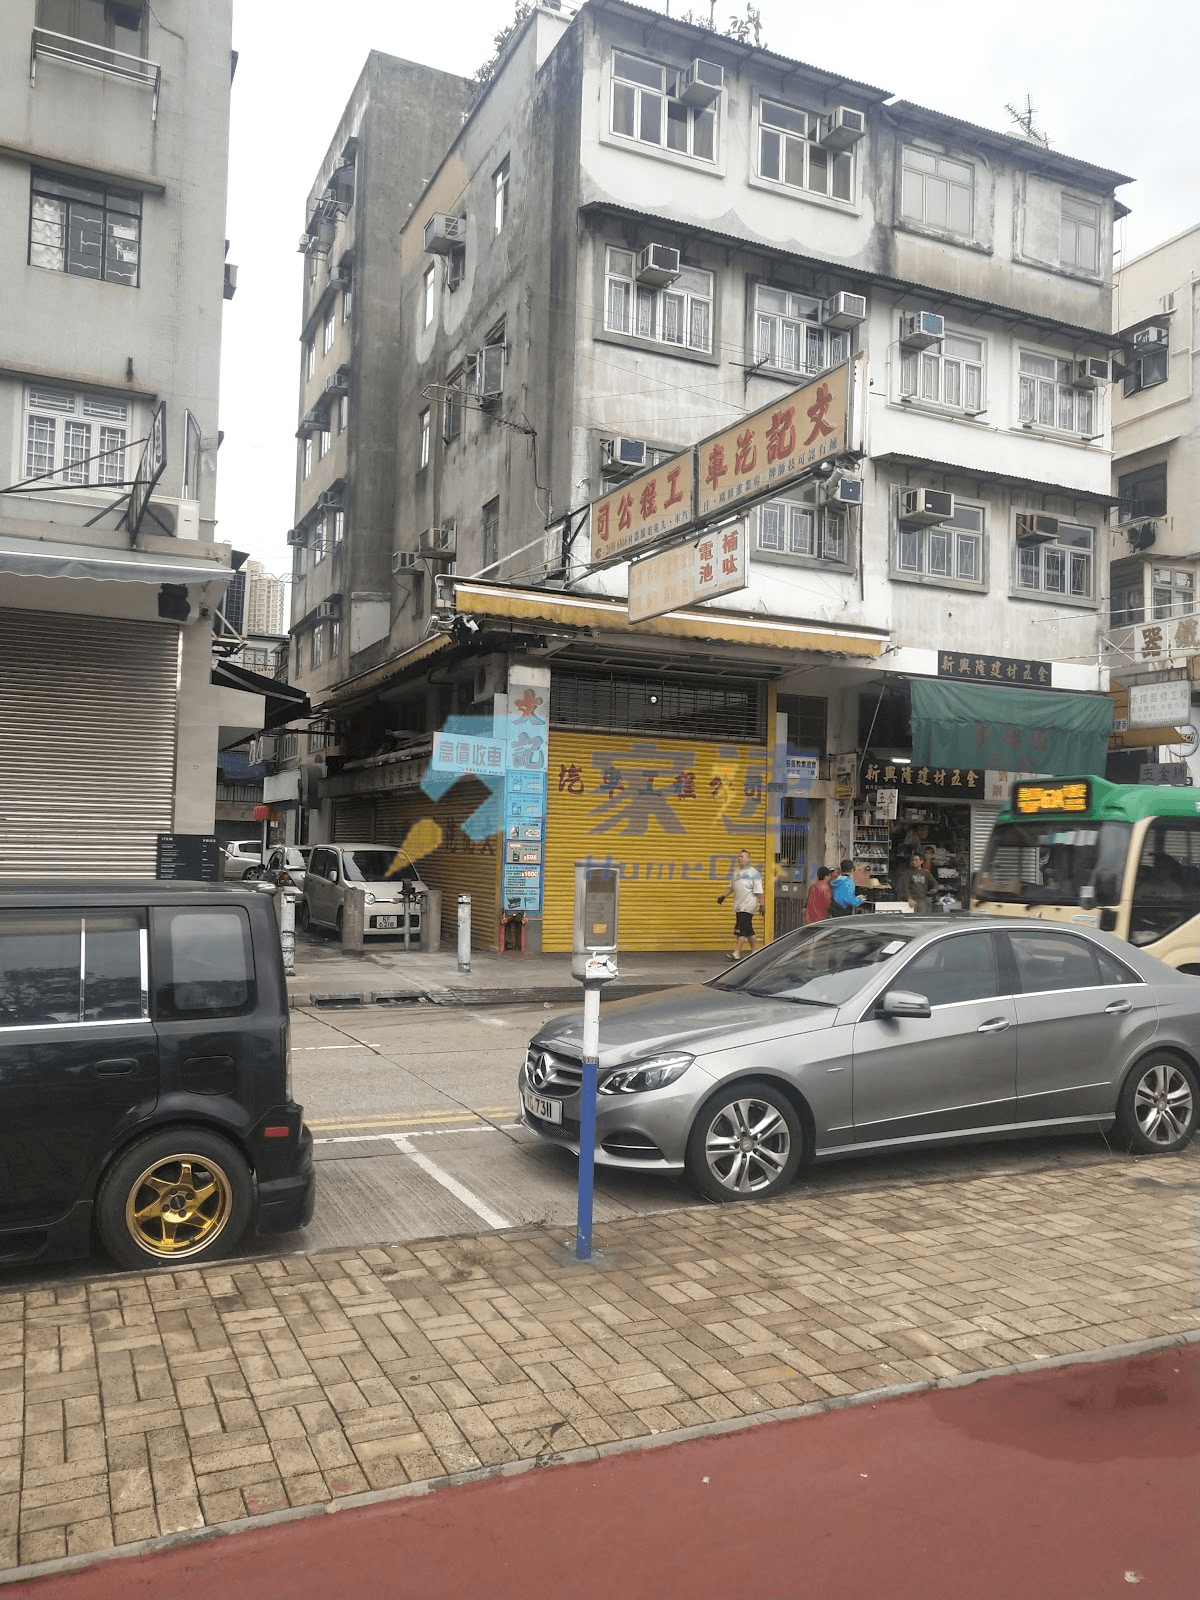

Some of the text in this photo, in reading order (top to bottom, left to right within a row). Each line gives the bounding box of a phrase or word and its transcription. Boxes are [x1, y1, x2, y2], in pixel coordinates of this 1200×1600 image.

[699, 541, 714, 585] 電池
[722, 530, 739, 576] 補呔
[941, 655, 1049, 682] 新興隆建材五金
[511, 688, 546, 770] 文記
[439, 740, 502, 768] 高價收車
[864, 764, 979, 788] 新興隆建材五金
[535, 1098, 551, 1118] 7311
